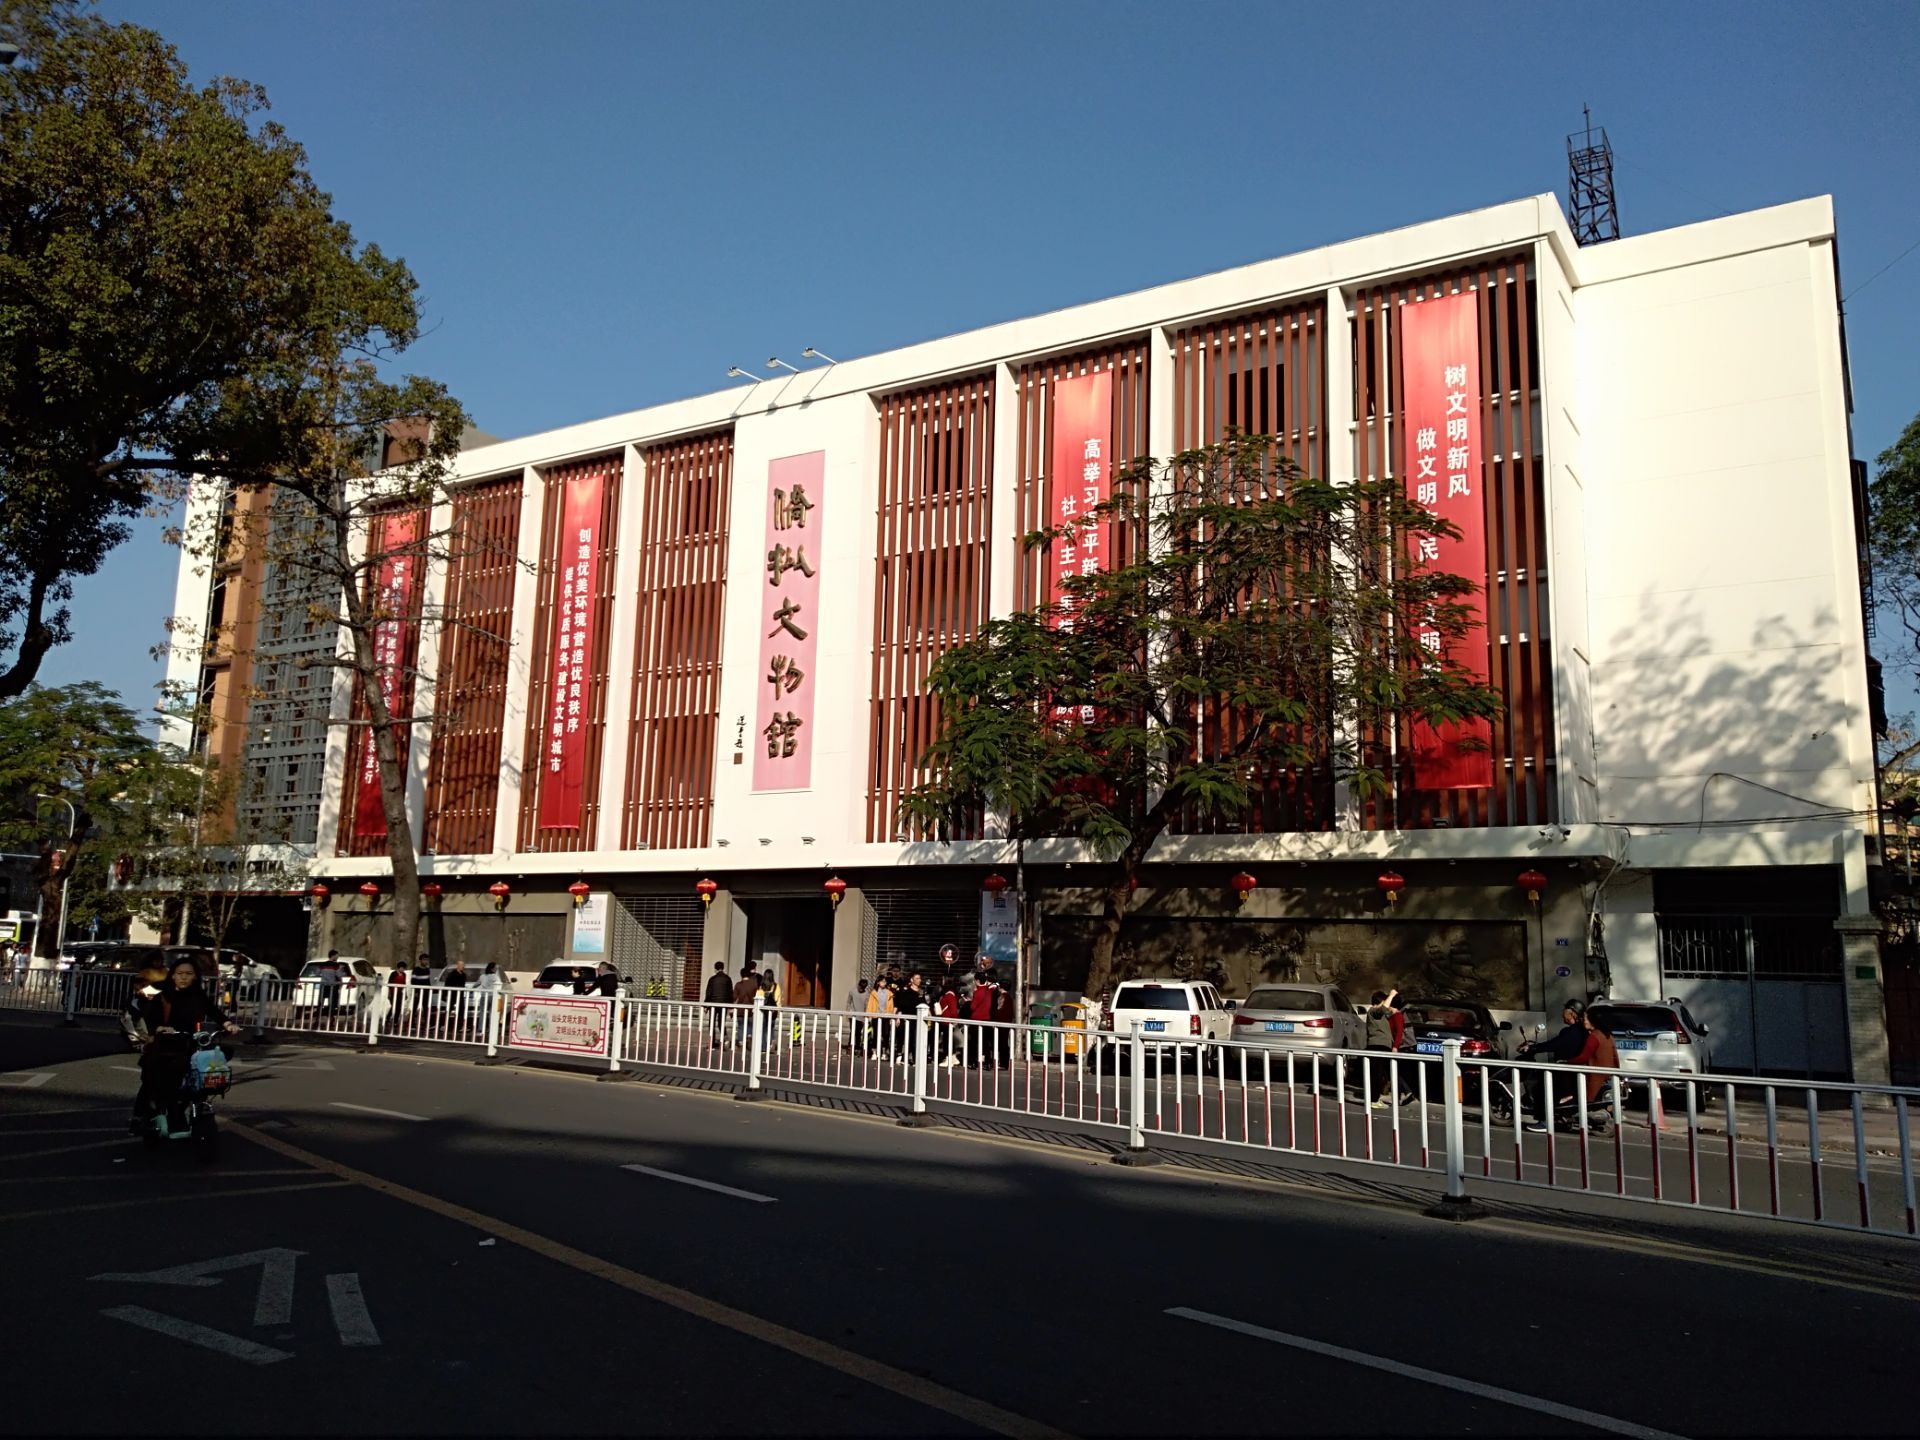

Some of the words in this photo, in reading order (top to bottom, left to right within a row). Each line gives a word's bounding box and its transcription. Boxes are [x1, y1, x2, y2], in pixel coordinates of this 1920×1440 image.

[1445, 363, 1471, 498] 树文明新风
[550, 567, 574, 773] 提供优质服务建设文明城市
[567, 528, 592, 733] 创造优美环境营造优良秩序
